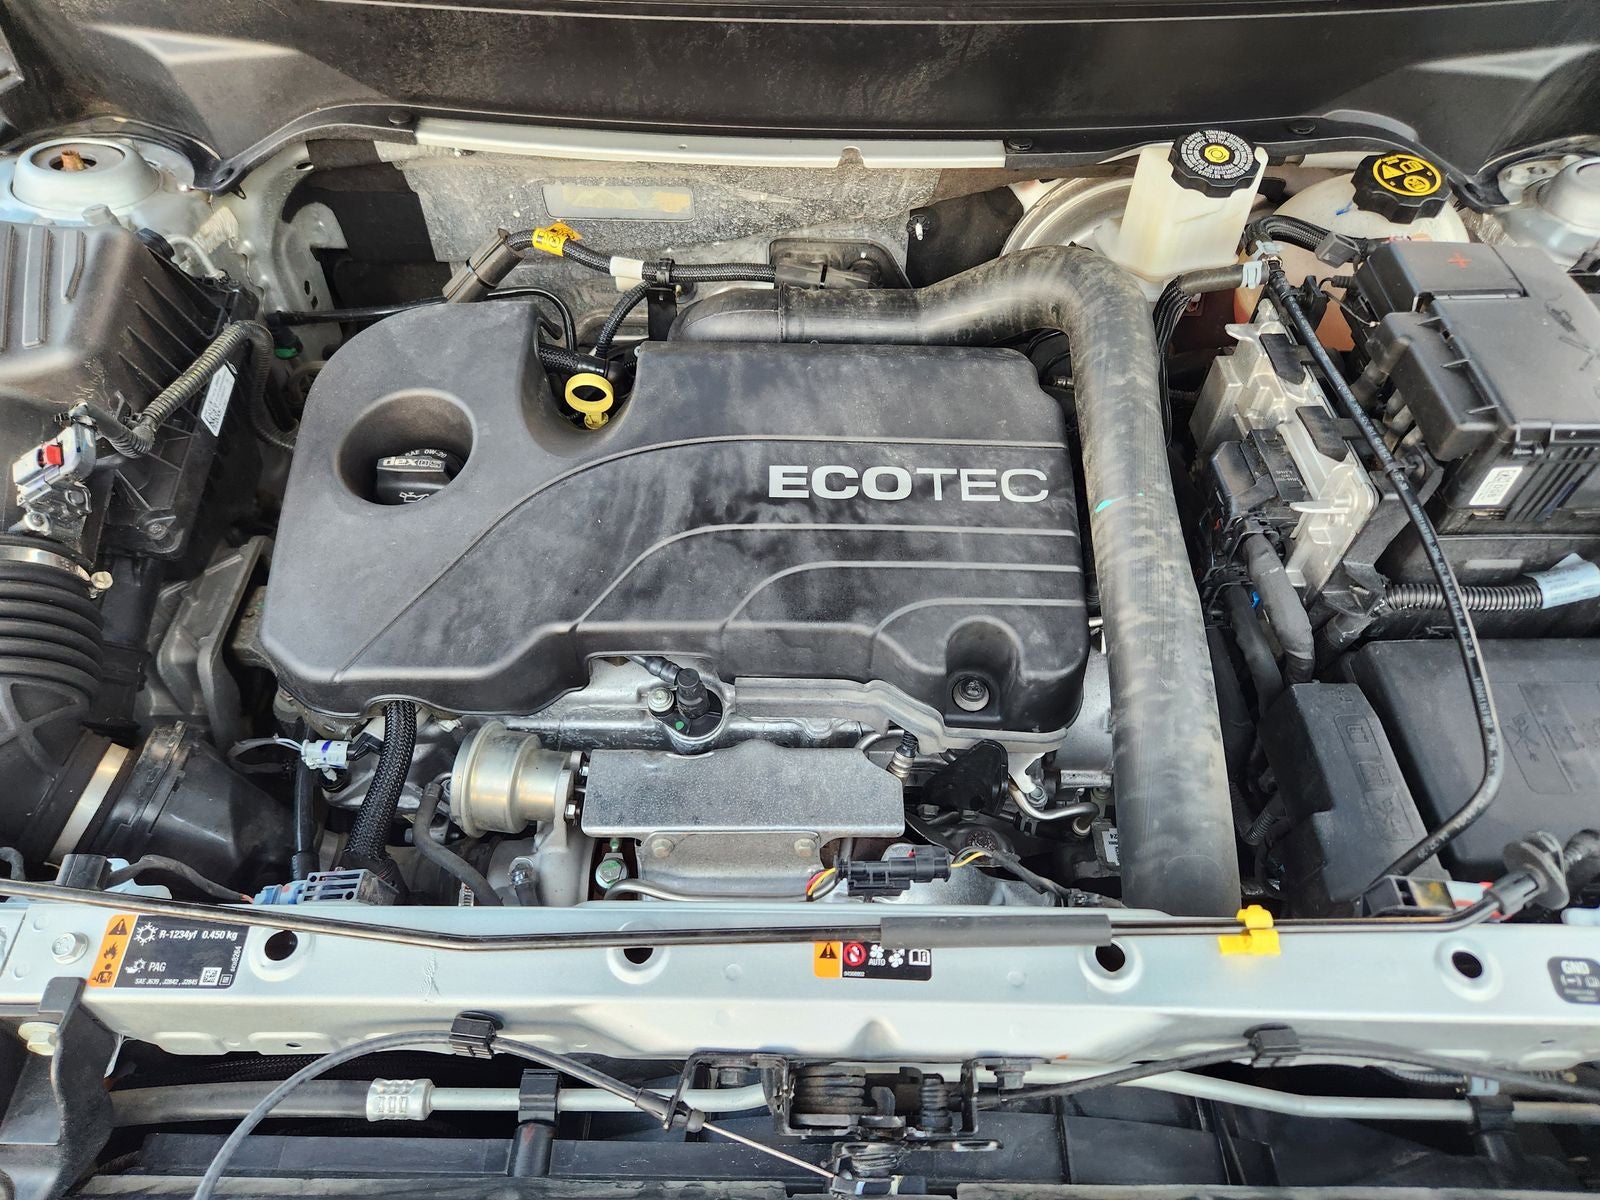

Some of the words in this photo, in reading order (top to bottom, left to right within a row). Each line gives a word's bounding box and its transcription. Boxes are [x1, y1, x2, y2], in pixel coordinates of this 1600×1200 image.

[424, 448, 448, 459] 0W-20
[382, 456, 442, 469] dexos
[768, 465, 1050, 503] ECOTEC
[158, 929, 198, 940] R-1234yf
[201, 930, 226, 940] 0.450
[225, 930, 239, 941] kg
[148, 961, 167, 972] PAG
[868, 958, 886, 966] AUTO
[134, 977, 147, 985] SAE
